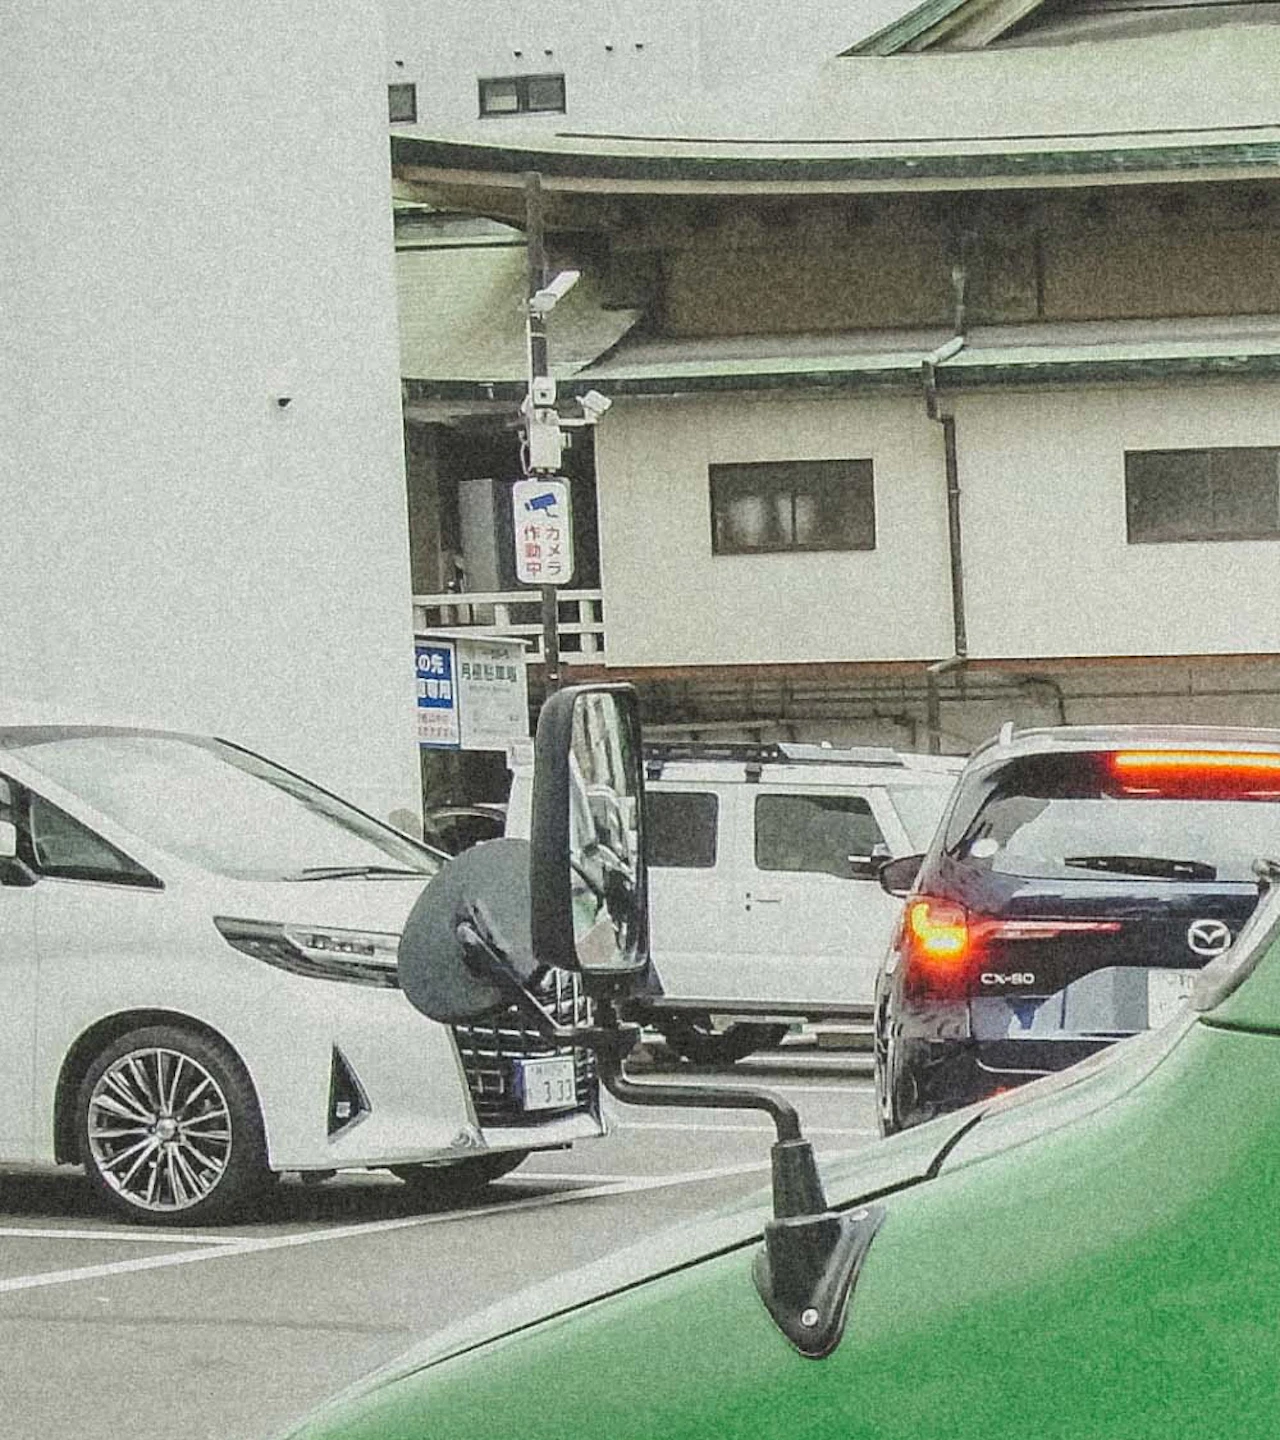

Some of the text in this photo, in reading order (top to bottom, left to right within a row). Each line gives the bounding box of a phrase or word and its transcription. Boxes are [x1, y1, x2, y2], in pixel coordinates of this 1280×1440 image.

[546, 526, 562, 577] カメラ
[415, 653, 444, 675] の先
